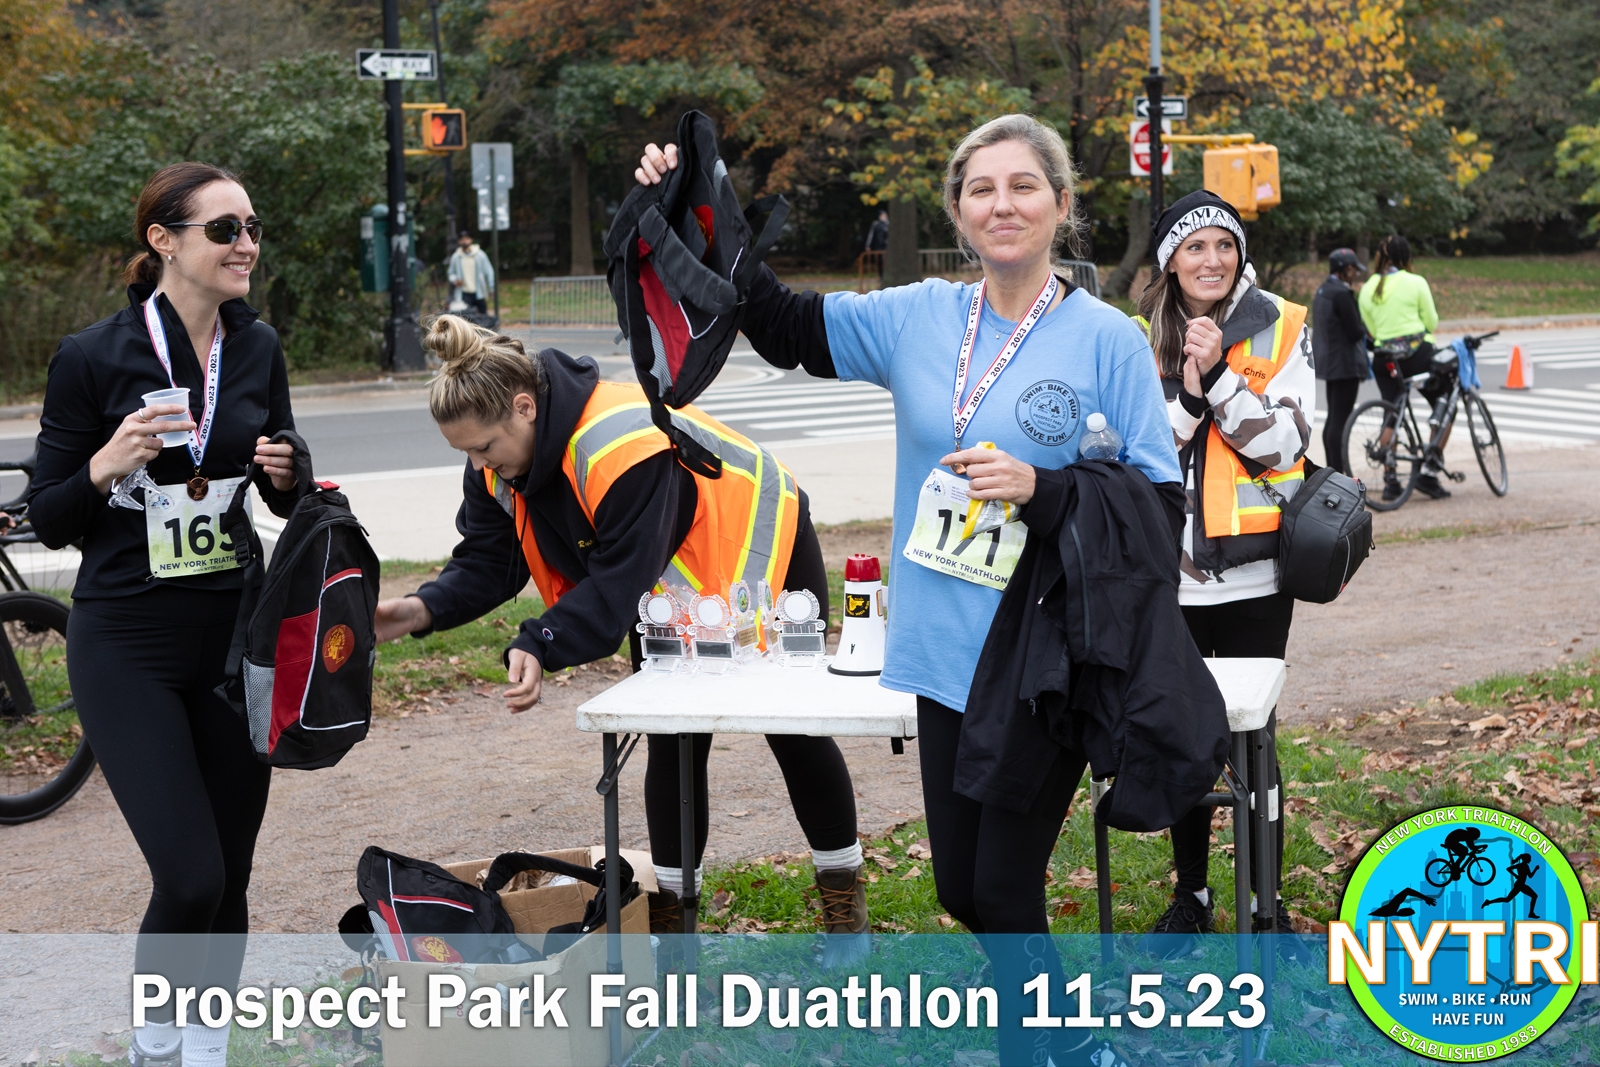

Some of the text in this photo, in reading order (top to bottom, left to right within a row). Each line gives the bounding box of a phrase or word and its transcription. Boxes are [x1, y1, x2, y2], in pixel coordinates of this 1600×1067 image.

[971, 296, 980, 316] 2023
[1030, 299, 1046, 320] 2023
[963, 327, 974, 347] 2023
[1010, 328, 1027, 348] 2023
[209, 353, 218, 374] 2023
[958, 357, 967, 378] 2023
[990, 357, 1007, 377] 2023
[1243, 367, 1266, 380] Chris
[208, 385, 216, 407] 2023
[970, 386, 986, 408] 2023
[1022, 383, 1077, 419] SWIM BIKE RUN
[200, 418, 211, 440] 2023
[1022, 419, 1067, 442] HAVE FUN!
[164, 512, 236, 558] 165
[159, 554, 237, 571] NEW YORK TRIATH
[913, 548, 1008, 584] NEW YORK TRIATHLON
